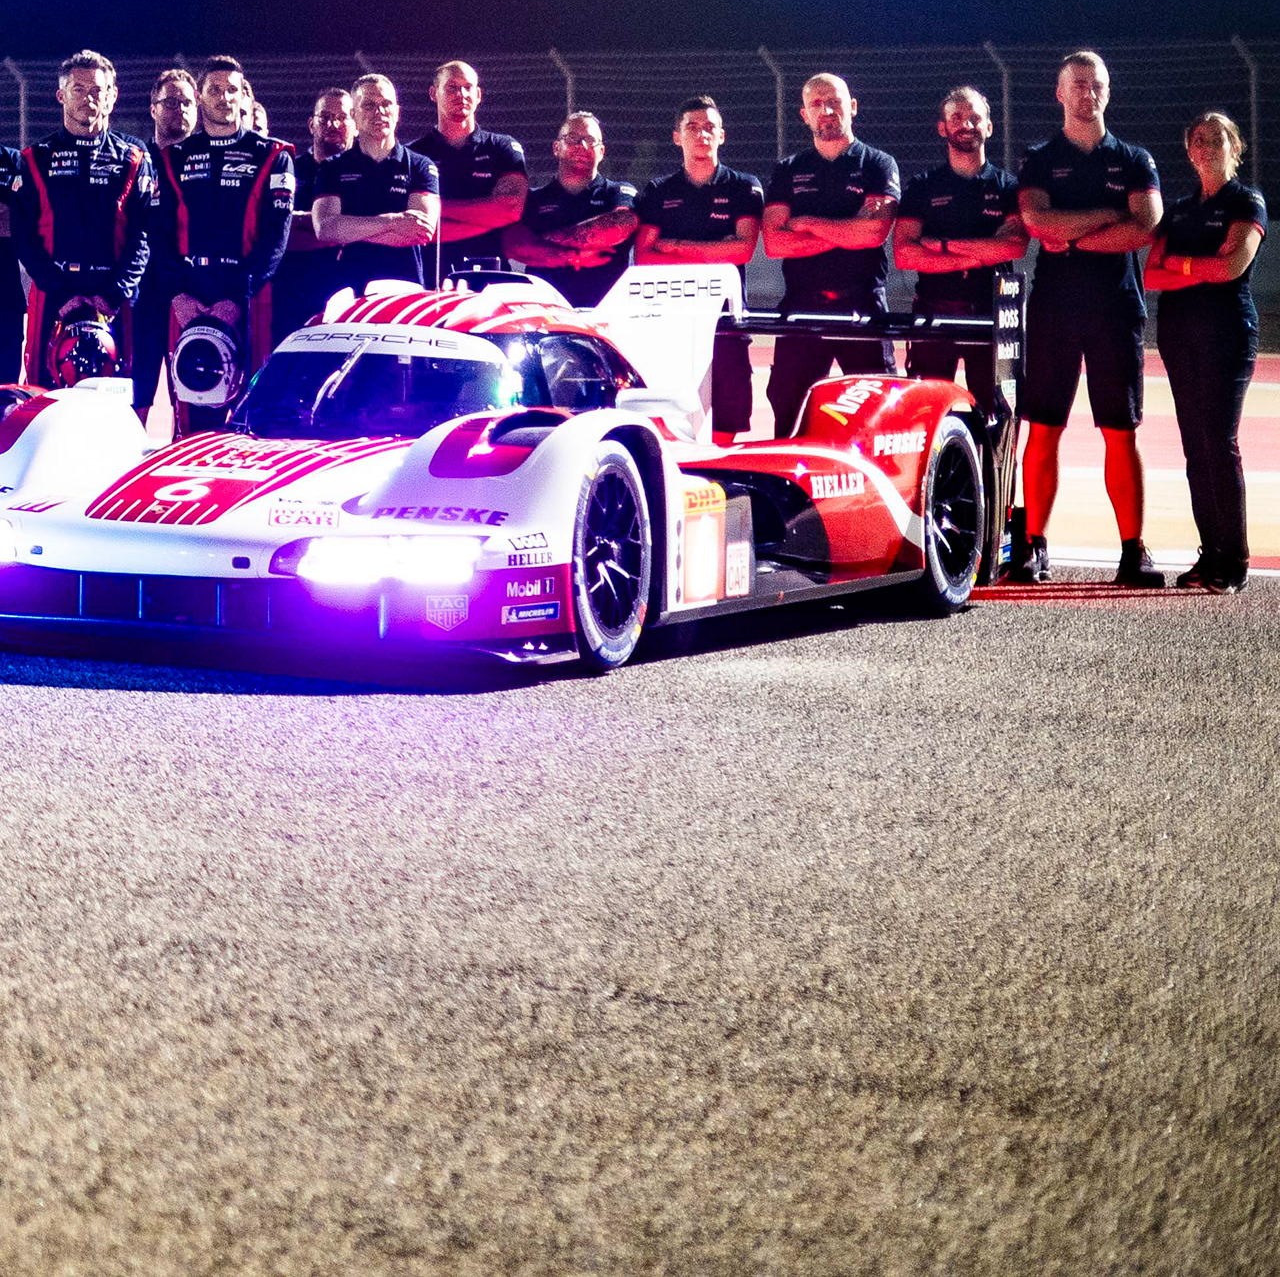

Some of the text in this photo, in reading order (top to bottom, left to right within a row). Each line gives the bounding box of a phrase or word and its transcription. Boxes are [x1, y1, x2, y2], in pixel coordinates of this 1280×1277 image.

[186, 153, 210, 162] Ansys
[221, 179, 240, 187] BOSS
[629, 280, 722, 299] PORSCHE
[999, 278, 1020, 298] Ansys
[999, 309, 1020, 329] BOSS
[291, 332, 459, 350] PORSCHE
[819, 379, 884, 426] Ansys
[874, 431, 927, 457] PENSKE
[153, 478, 215, 502] 6
[810, 473, 865, 500] HELLER
[685, 489, 721, 509] DHL
[274, 515, 334, 525] CAR
[371, 506, 509, 527] PENSKE
[507, 552, 553, 567] HELLER
[506, 579, 541, 598] Mobil
[431, 596, 465, 609] TAG
[428, 610, 466, 631] HEUER
[517, 607, 555, 618] MICHELIN
